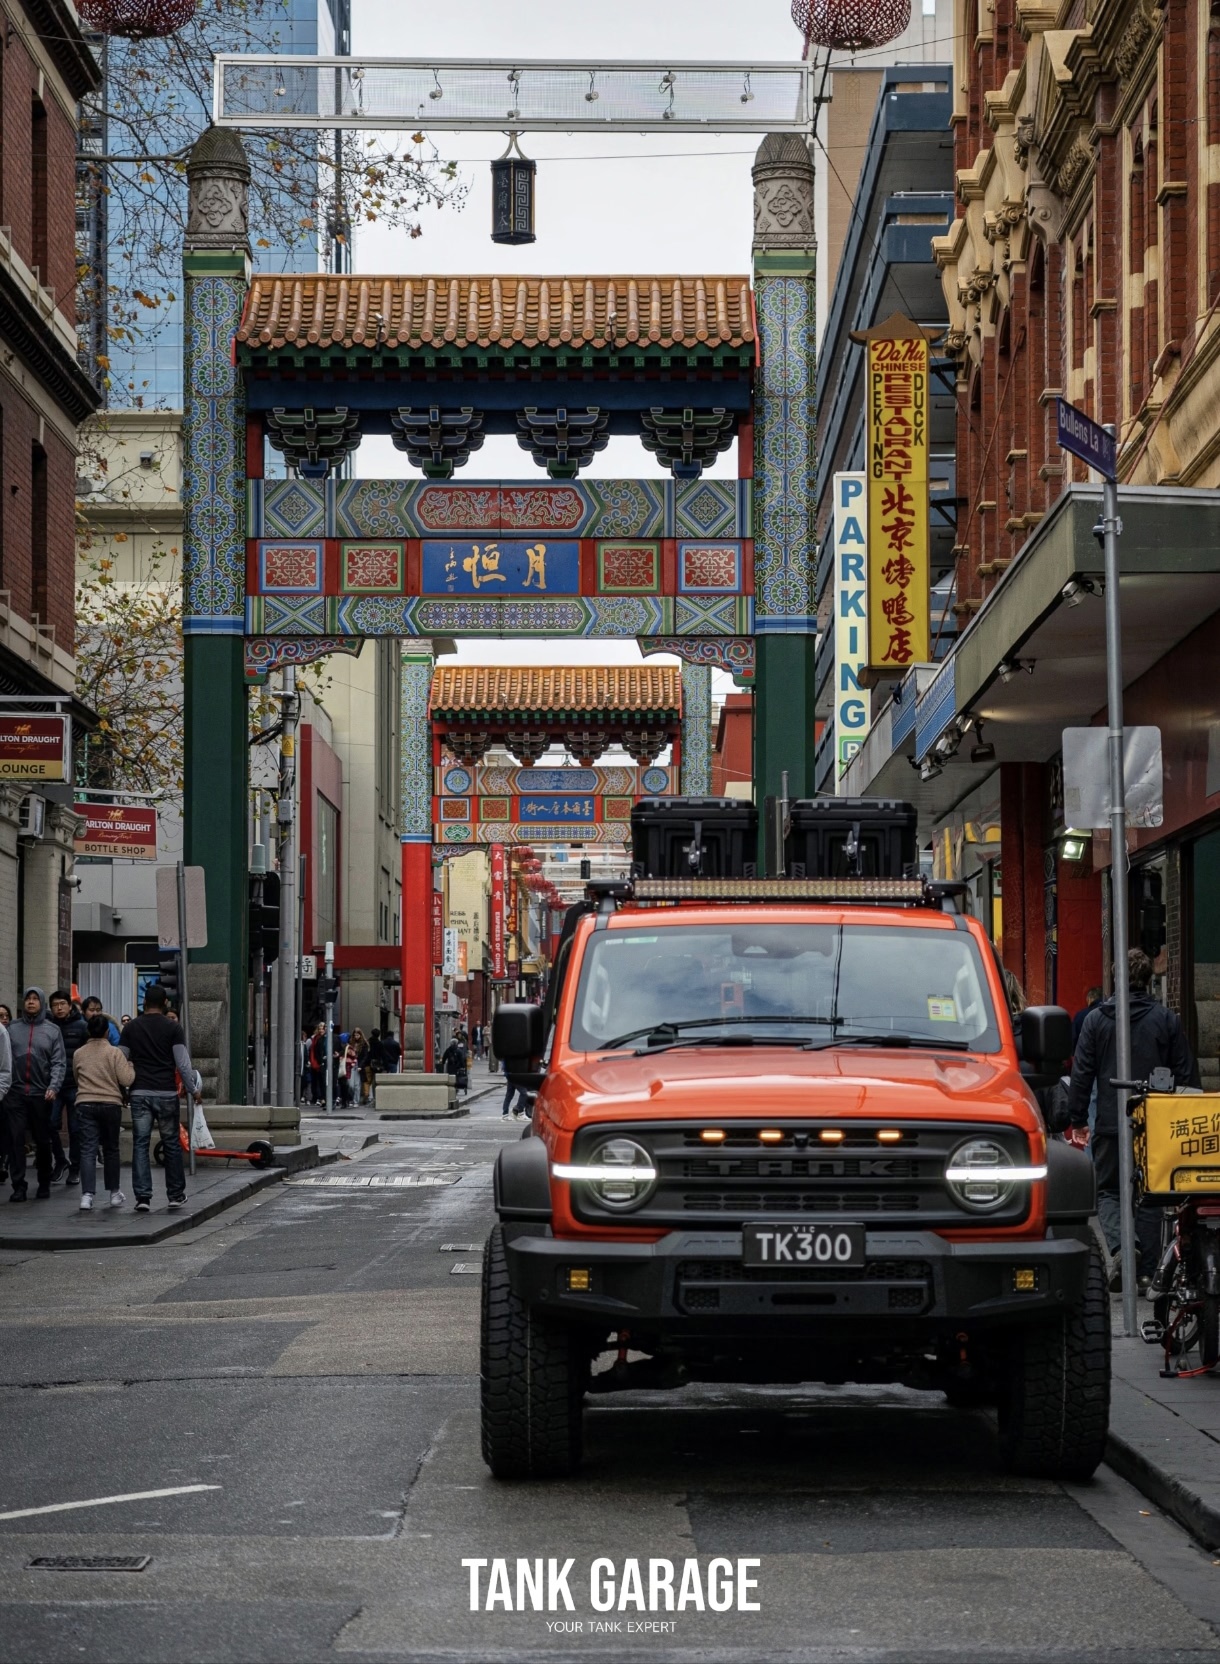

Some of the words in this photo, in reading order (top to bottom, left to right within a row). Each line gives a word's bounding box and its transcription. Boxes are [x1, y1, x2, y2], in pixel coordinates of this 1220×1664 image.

[871, 339, 902, 361] Da
[901, 339, 926, 361] Hu
[871, 362, 926, 372] CHINESE
[913, 373, 924, 447] DUCK
[873, 373, 884, 479] PEKING
[884, 373, 912, 480] RESTAURANT
[1060, 403, 1089, 445] Bullens
[1089, 423, 1099, 453] La
[880, 483, 916, 664] 北京烤鴨店
[839, 480, 867, 729] PARKING
[21, 735, 61, 744] DRAUGHT
[0, 763, 46, 774] OUNGE
[84, 820, 114, 830] ARLTON
[114, 821, 152, 832] DRAUGHT
[84, 843, 118, 854] BOTTLE
[121, 845, 146, 855] SHOP
[494, 942, 501, 952] OF
[1181, 1134, 1220, 1157] 中国
[707, 1160, 894, 1175] TANK
[792, 1225, 816, 1233] VIC
[755, 1232, 852, 1261] TK300
